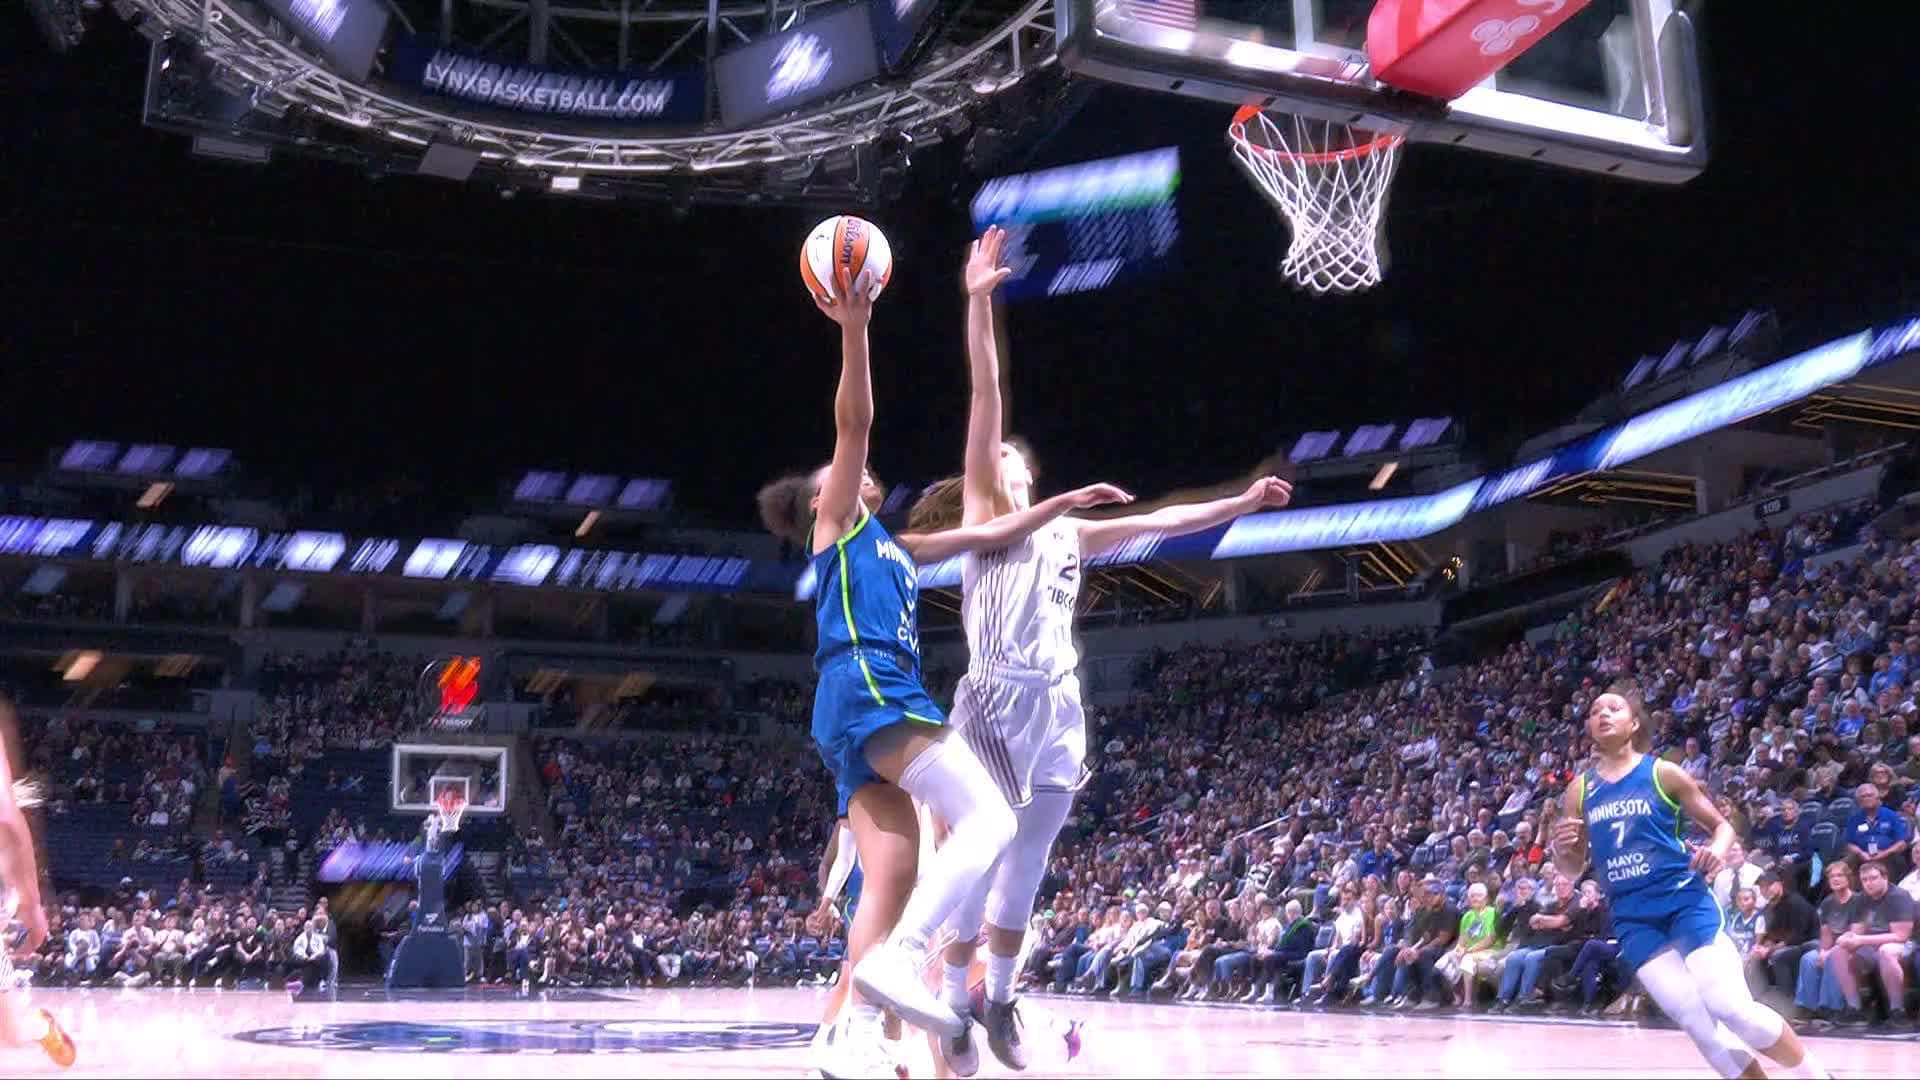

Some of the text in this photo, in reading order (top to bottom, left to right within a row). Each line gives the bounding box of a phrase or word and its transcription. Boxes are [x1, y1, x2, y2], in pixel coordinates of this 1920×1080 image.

[424, 58, 670, 117] LYNXBASKETBALL.COM
[1588, 799, 1652, 824] MINNESOTA
[1611, 821, 1625, 848] 7
[1607, 852, 1644, 870] MAYO
[1607, 863, 1651, 882] CLINIC
